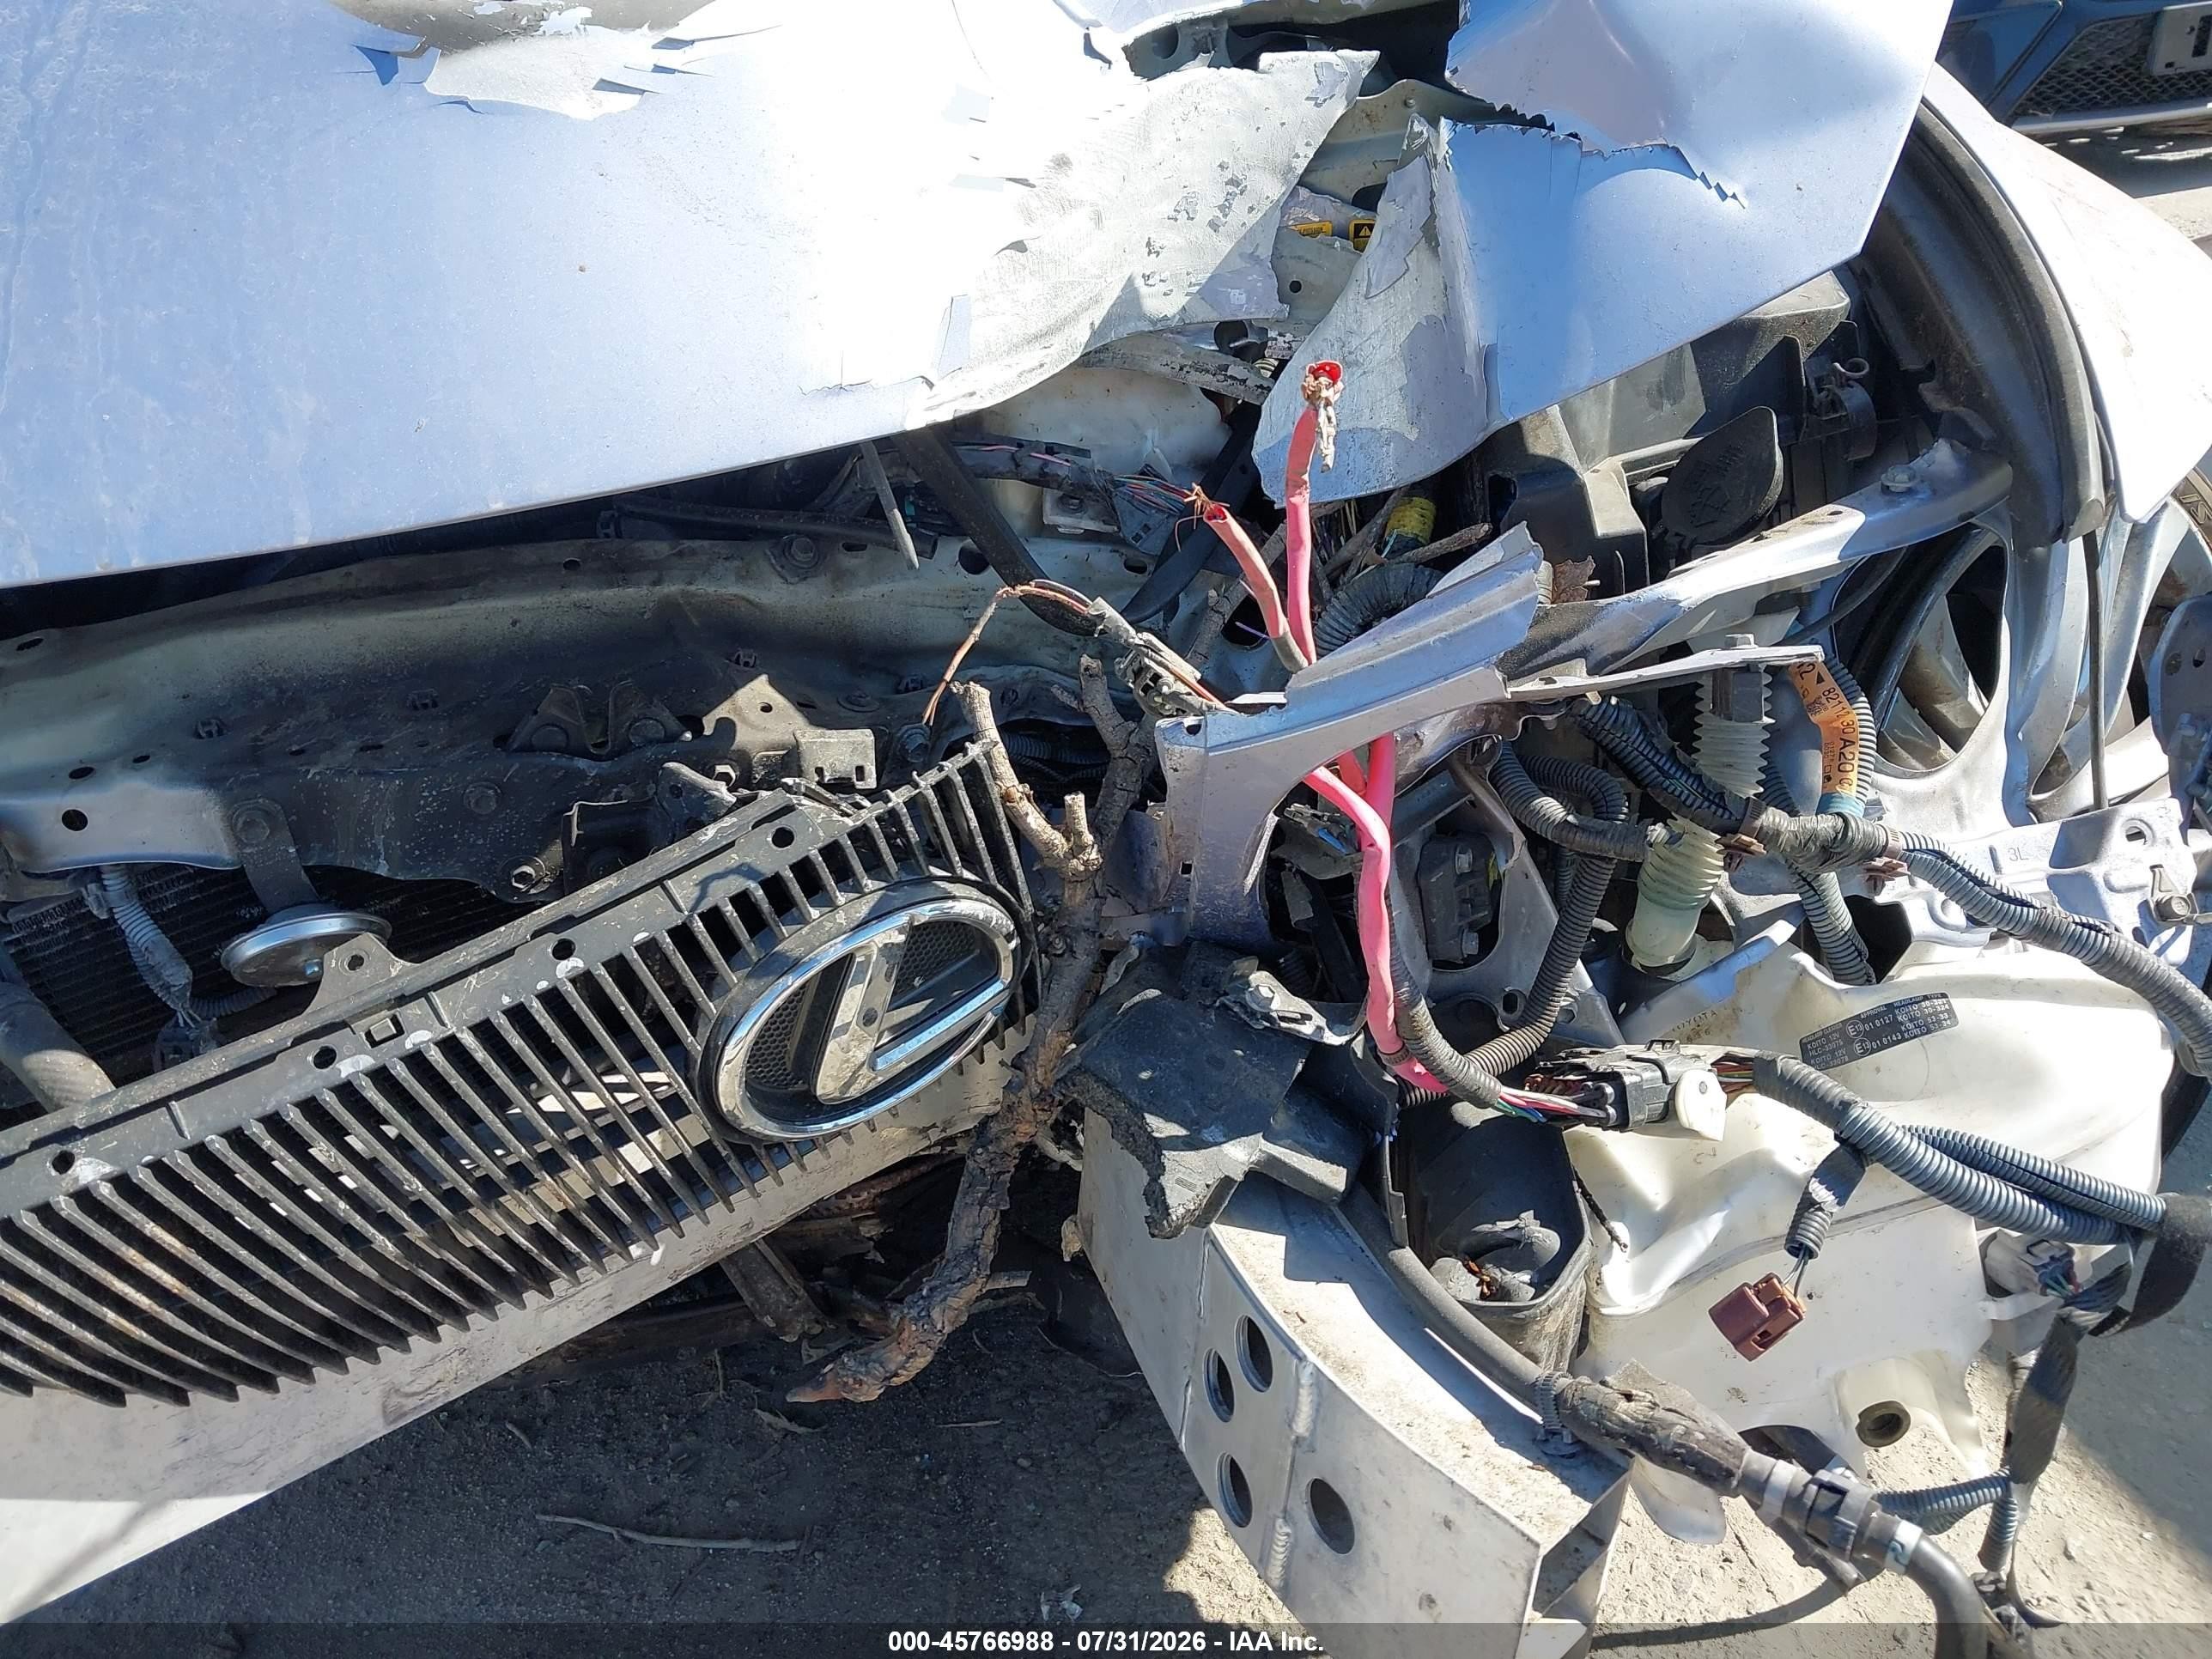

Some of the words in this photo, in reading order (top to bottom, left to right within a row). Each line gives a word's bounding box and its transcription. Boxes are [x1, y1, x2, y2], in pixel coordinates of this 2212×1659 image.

[1860, 1005, 1888, 1019] APPROVAL
[1894, 1004, 1918, 1016] KOITO
[1897, 1010, 1921, 1022] KOITO
[1875, 1014, 1893, 1027] 0127
[1900, 1019, 1924, 1032] KOITO
[1882, 1032, 1902, 1045] 0143
[1904, 1026, 1927, 1039] KOITO
[1808, 1037, 1826, 1050] KOITO
[1810, 1054, 1832, 1066] KOITO
